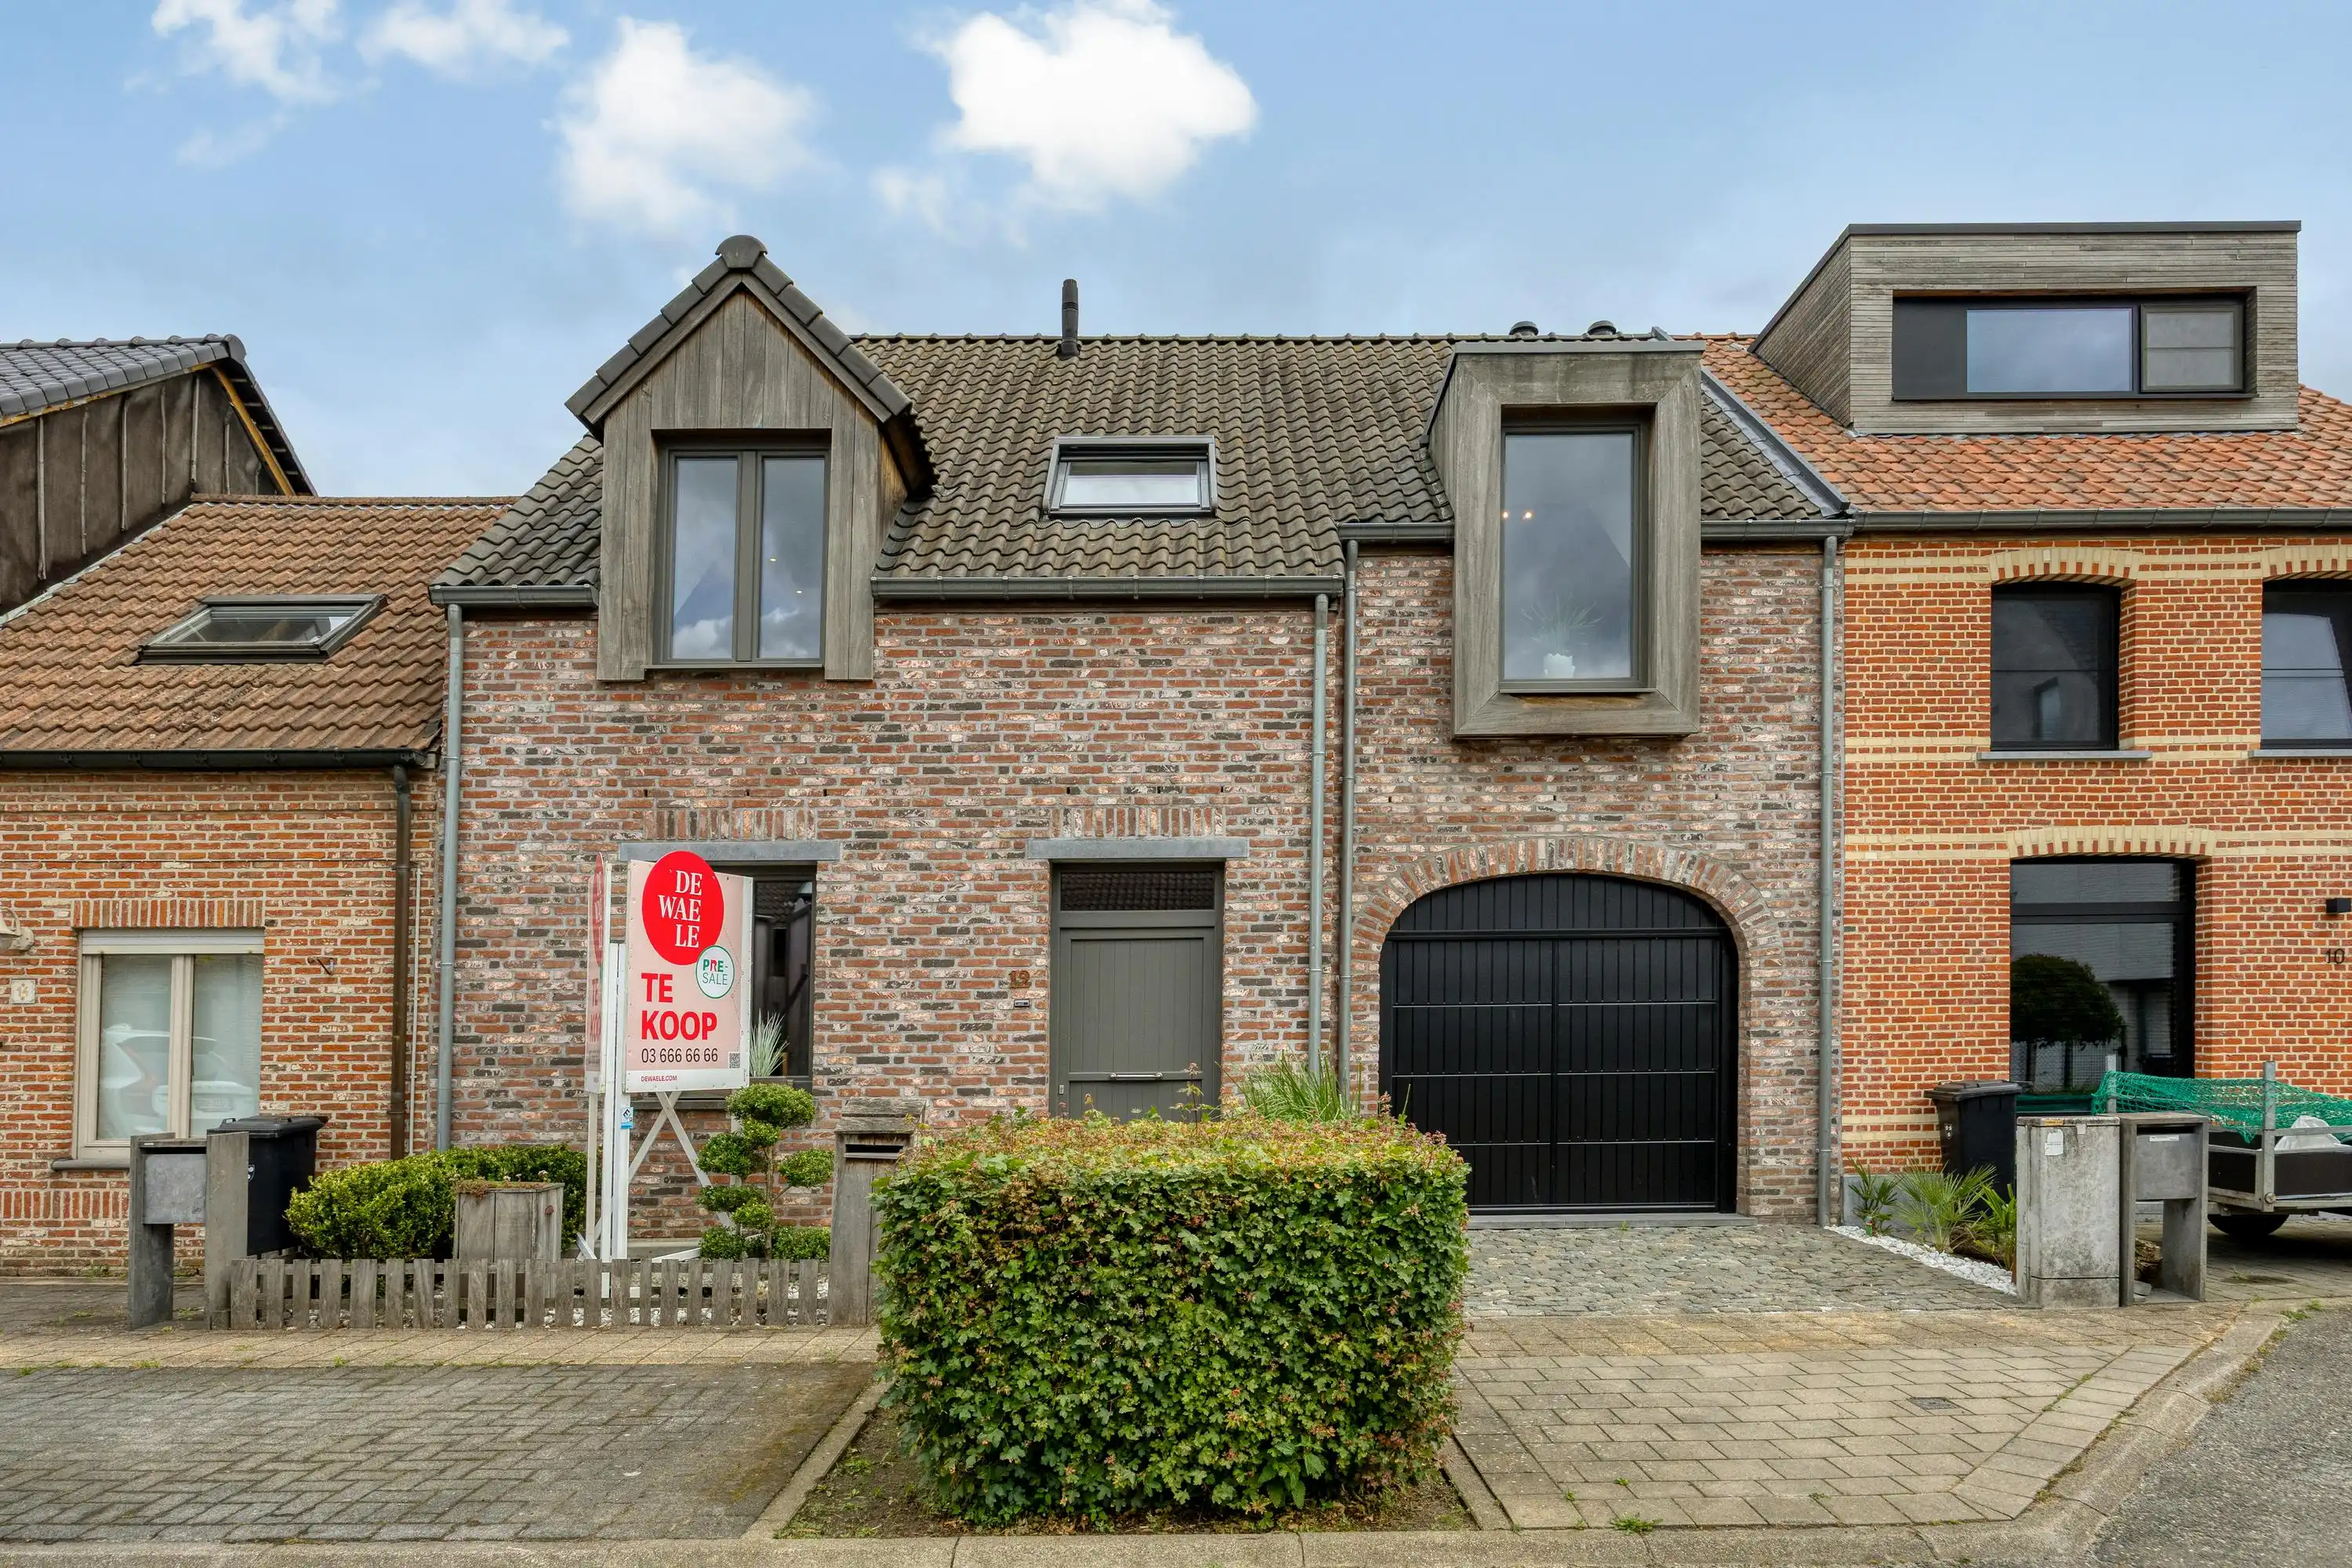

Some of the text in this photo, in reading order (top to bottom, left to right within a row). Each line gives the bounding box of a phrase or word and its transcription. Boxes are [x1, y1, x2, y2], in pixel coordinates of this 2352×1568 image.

[675, 869, 702, 896] DE
[658, 894, 702, 922] WAE
[675, 924, 700, 948] LE
[702, 959, 728, 973] PRE-
[2326, 948, 2345, 964] 10
[641, 972, 673, 1004] TE
[702, 971, 728, 985] SALE
[641, 1010, 718, 1041] KOOP
[641, 1047, 718, 1063] 03 666 66 66
